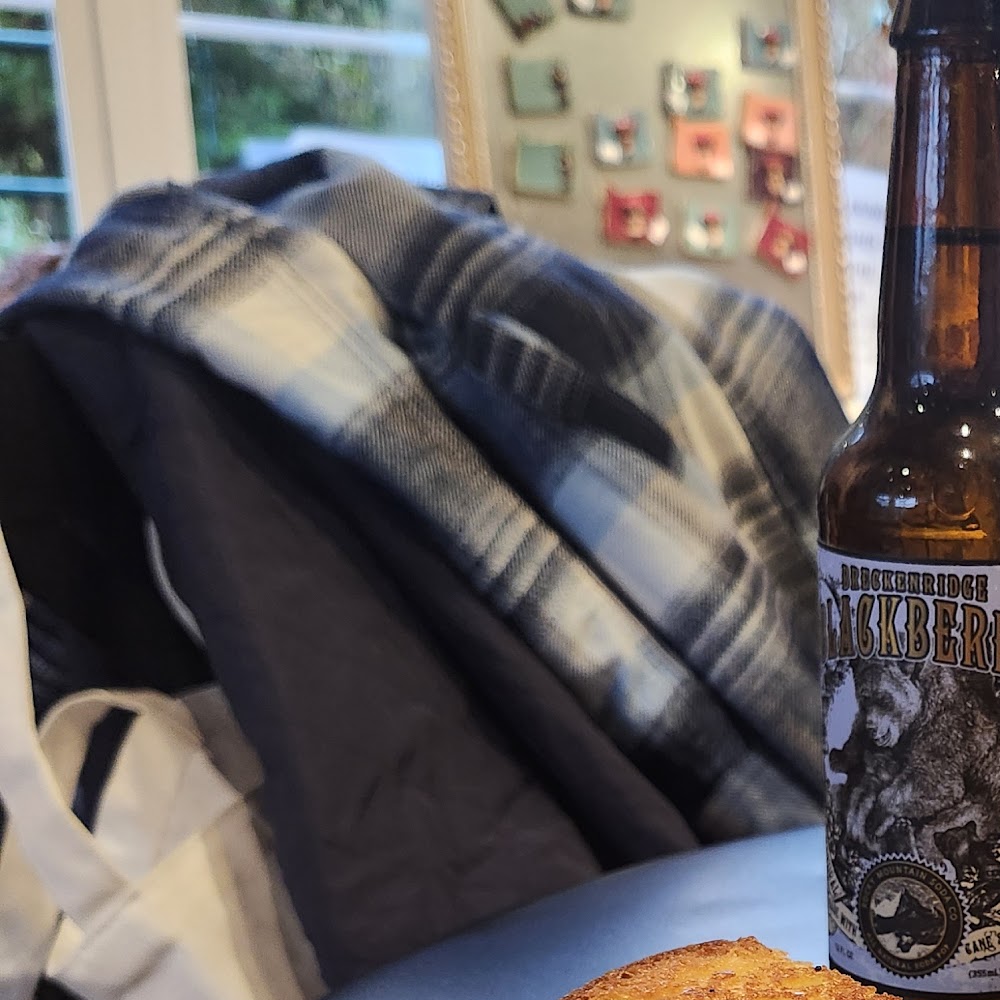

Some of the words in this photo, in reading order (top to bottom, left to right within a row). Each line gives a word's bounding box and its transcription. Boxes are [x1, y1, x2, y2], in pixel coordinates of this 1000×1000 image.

[841, 564, 989, 603] BRECKENRIDGE
[876, 865, 928, 880] MOUNTAIN
[929, 879, 952, 902] SODA
[965, 934, 994, 956] CANE
